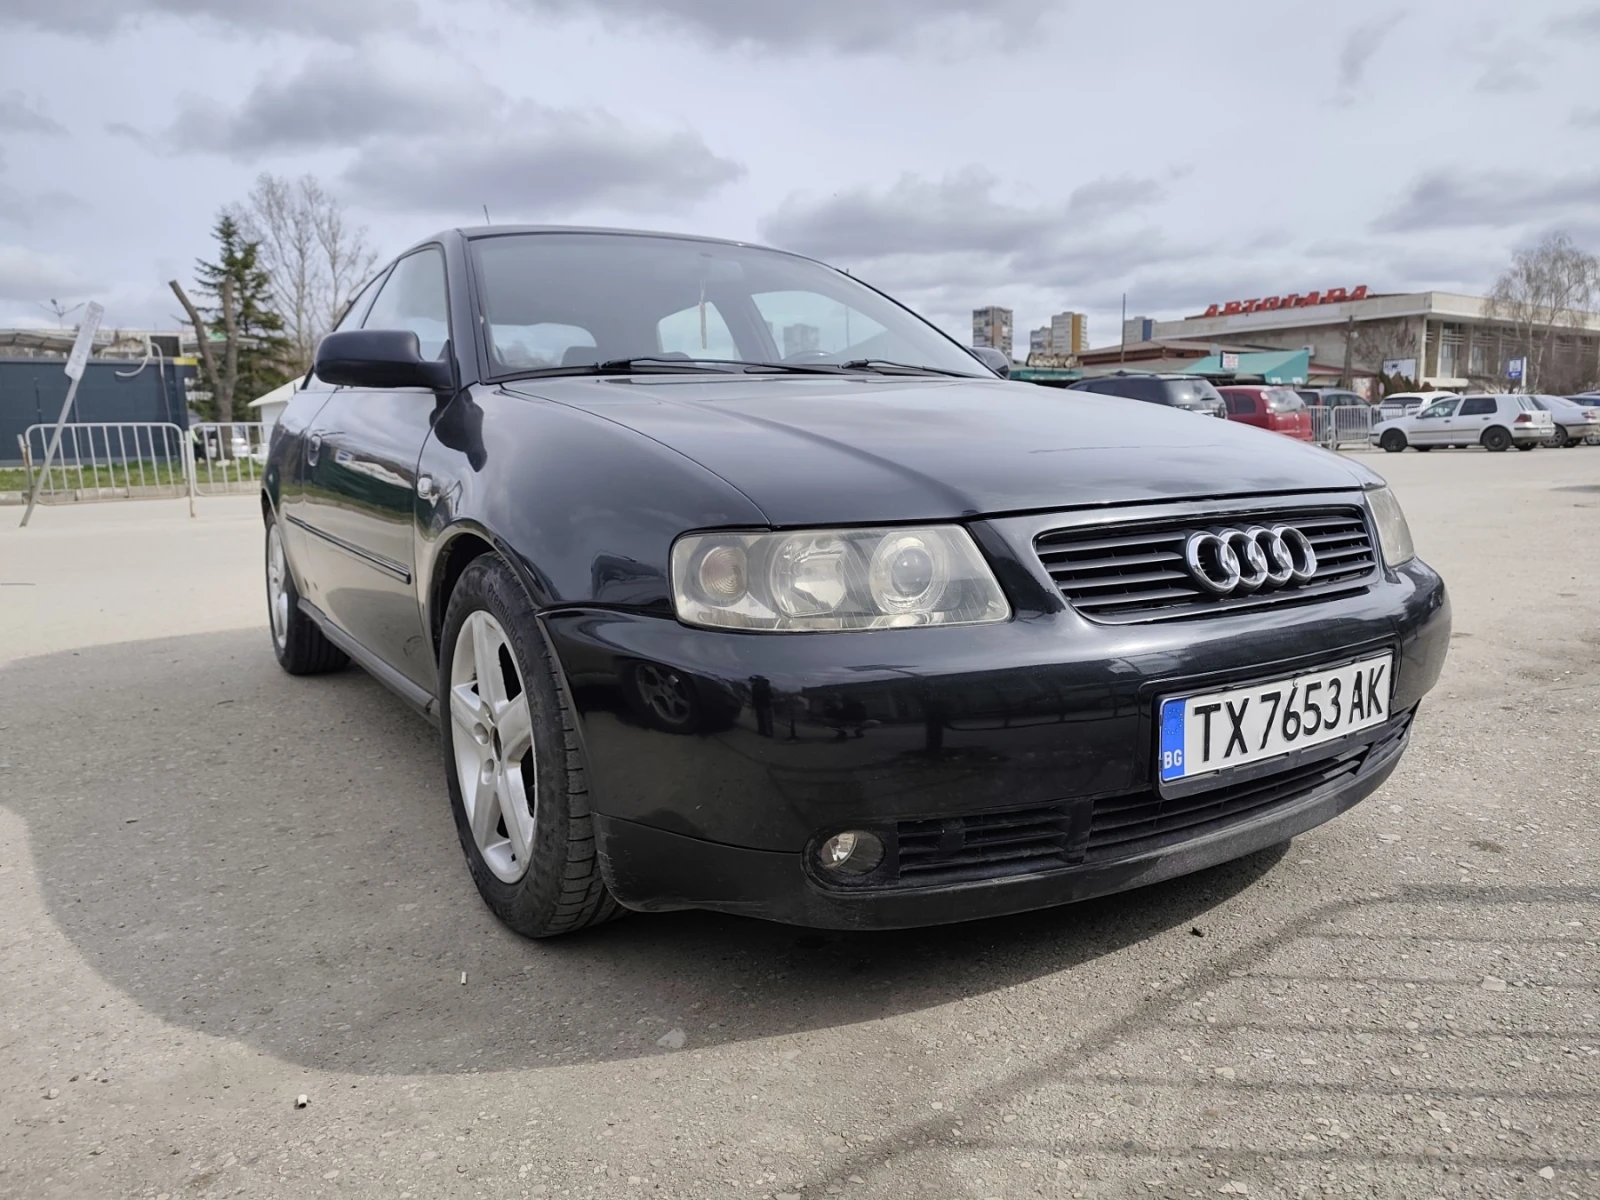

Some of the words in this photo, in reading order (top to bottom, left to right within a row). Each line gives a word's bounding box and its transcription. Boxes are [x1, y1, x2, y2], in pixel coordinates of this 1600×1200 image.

[1203, 285, 1367, 317] АВТОГАРА
[1194, 697, 1250, 763] TX
[1259, 677, 1342, 750] 7653
[1348, 664, 1386, 724] AK
[1163, 749, 1182, 769] BG
